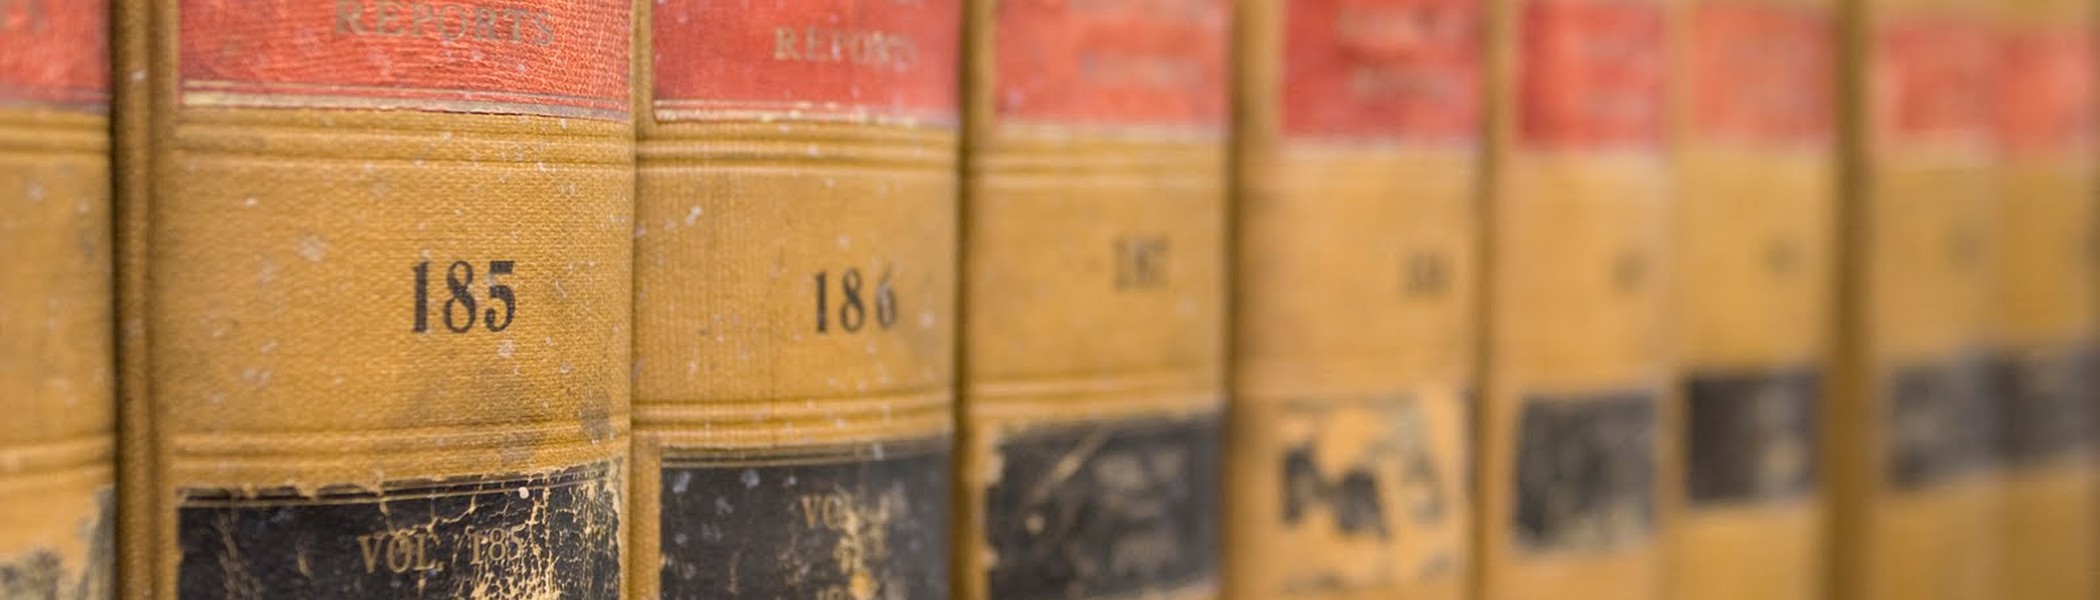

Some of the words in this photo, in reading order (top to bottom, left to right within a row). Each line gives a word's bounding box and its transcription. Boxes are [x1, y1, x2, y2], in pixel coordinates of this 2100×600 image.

[336, 0, 555, 46] REPORTS
[411, 260, 516, 333] 185
[815, 262, 898, 334] 186
